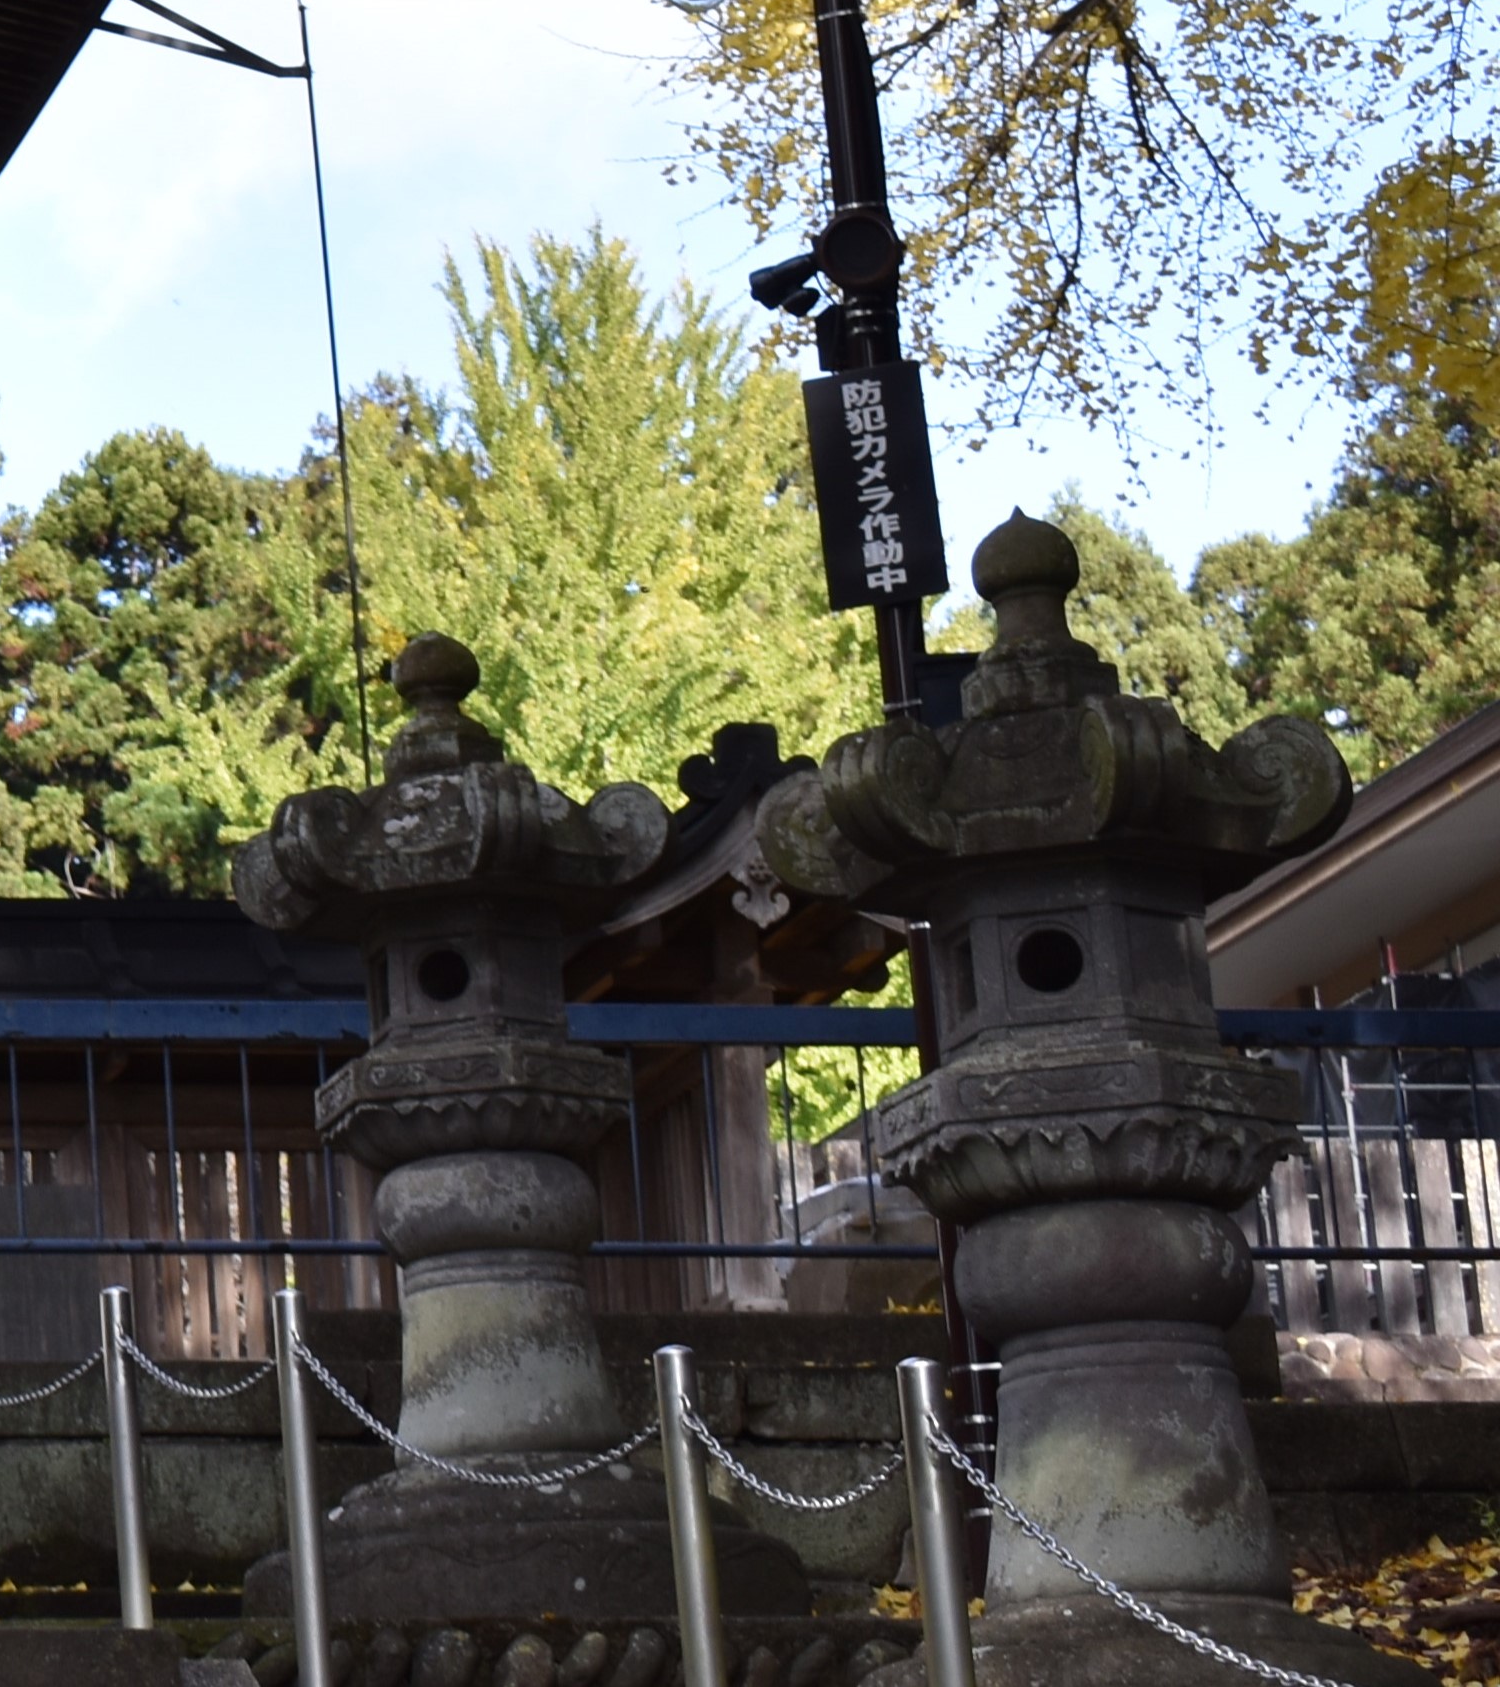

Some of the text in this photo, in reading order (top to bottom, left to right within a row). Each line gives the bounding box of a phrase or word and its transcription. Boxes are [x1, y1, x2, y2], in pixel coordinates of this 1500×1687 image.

[840, 379, 907, 593] 防犯カメラ作動中
